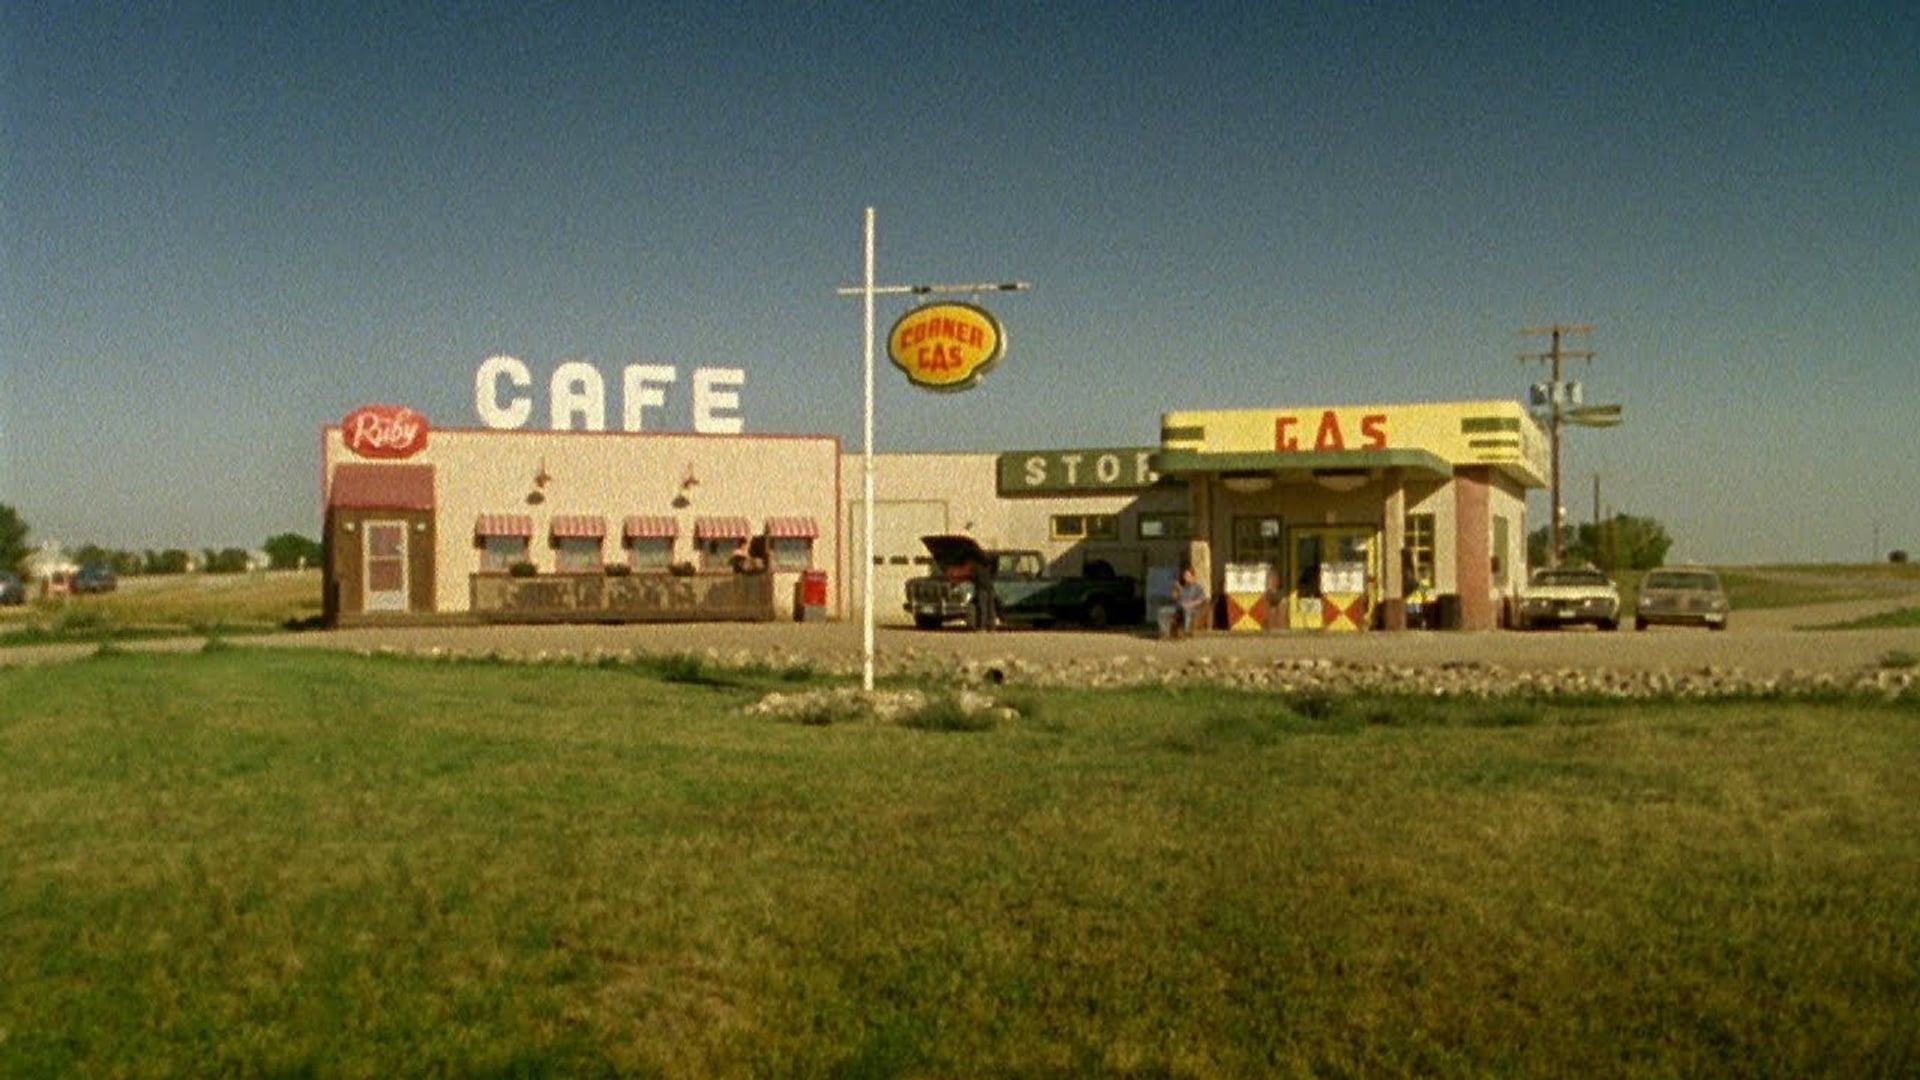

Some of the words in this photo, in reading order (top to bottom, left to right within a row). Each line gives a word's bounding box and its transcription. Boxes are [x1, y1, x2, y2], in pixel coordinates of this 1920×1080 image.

[918, 344, 964, 371] GAS
[475, 354, 745, 434] CAFE
[353, 408, 419, 449] Ruby
[1275, 410, 1387, 452] GAS
